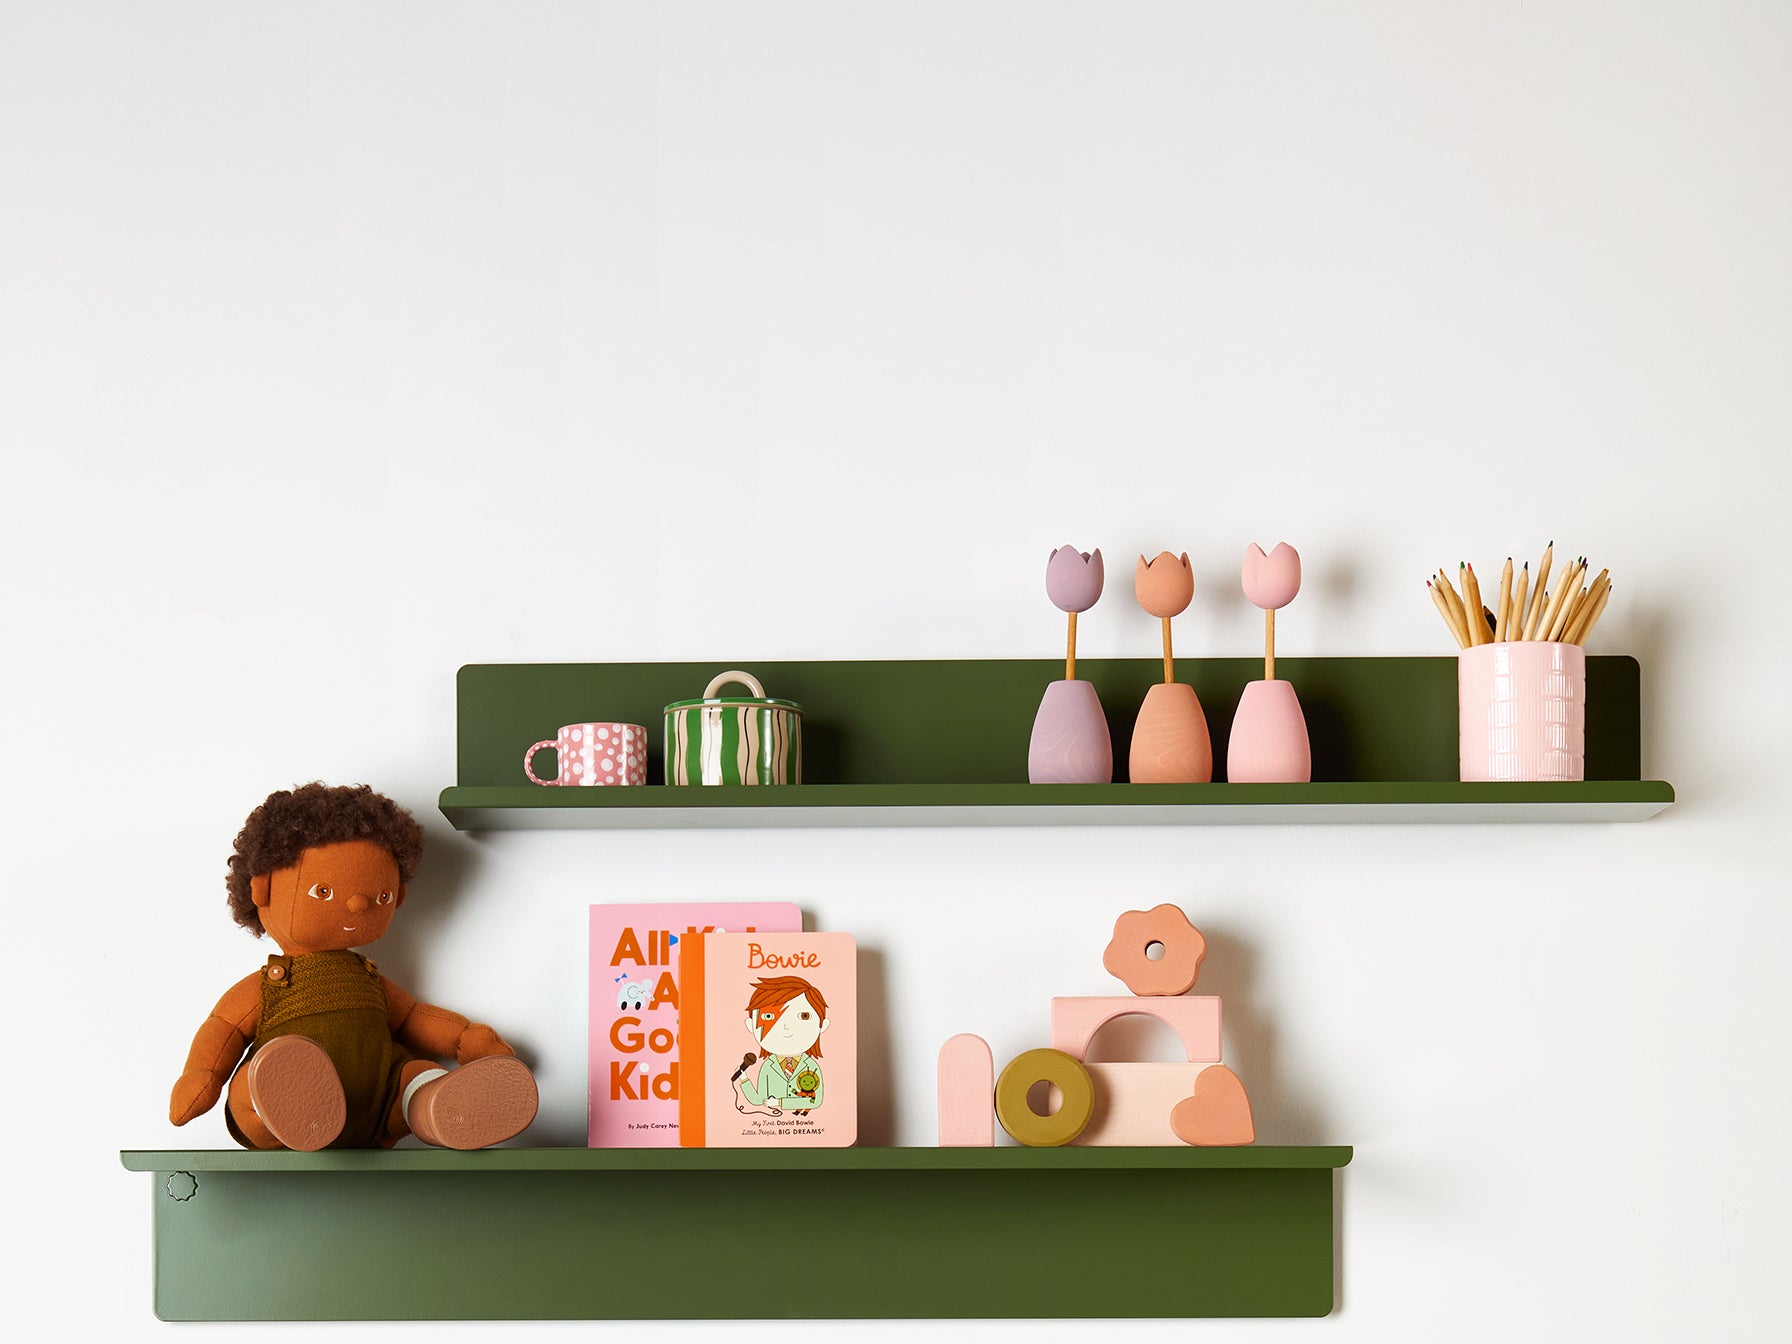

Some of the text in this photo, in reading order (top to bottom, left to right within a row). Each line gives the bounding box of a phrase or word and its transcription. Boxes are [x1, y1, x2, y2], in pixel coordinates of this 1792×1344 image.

[610, 927, 670, 966] All
[747, 943, 821, 969] Bowie
[610, 1016, 679, 1053] Go
